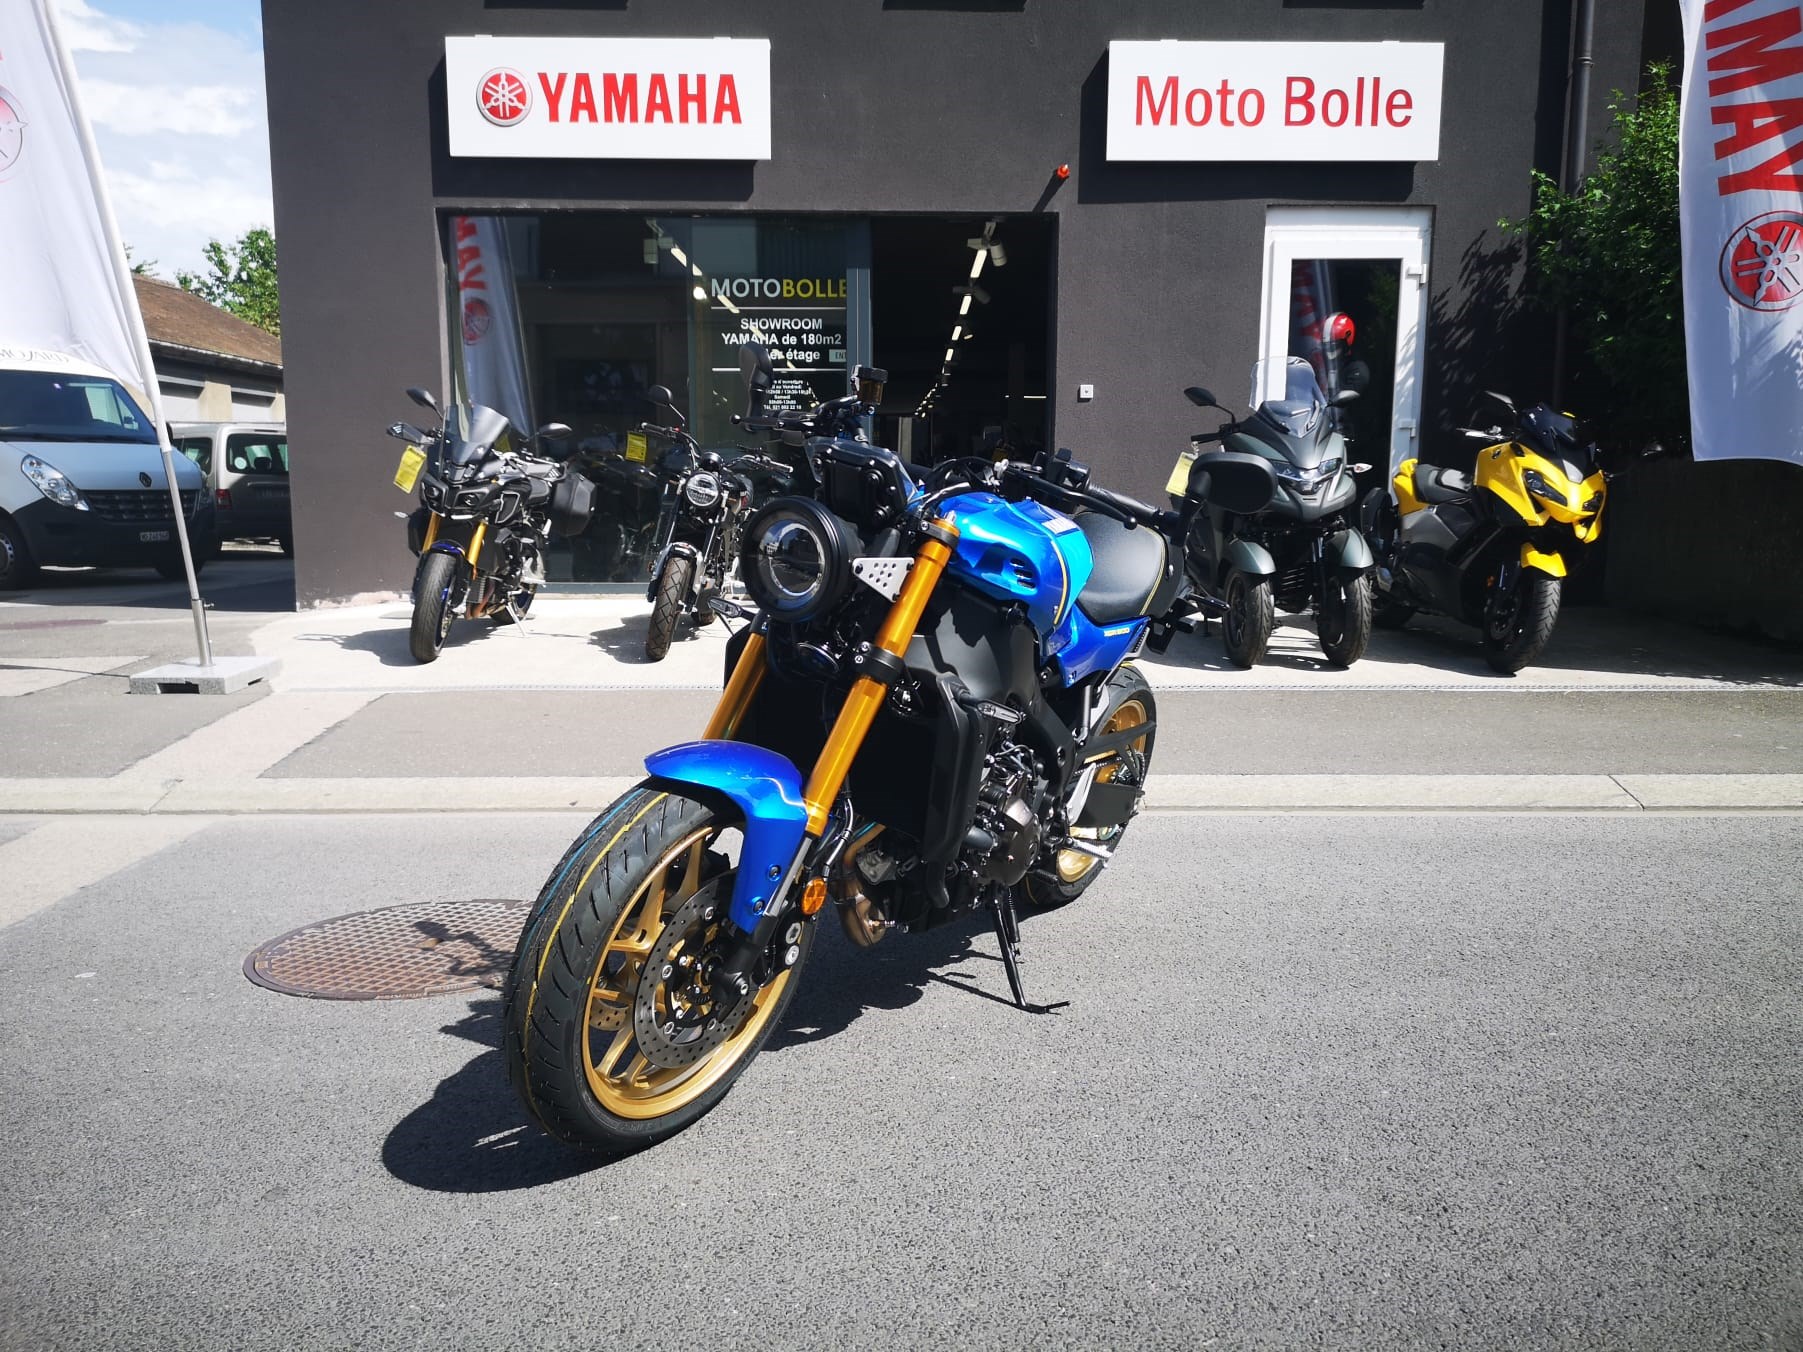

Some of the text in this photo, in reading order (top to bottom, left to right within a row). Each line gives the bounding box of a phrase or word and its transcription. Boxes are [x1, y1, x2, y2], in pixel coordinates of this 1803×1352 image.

[537, 71, 743, 125] YAMAHA
[1135, 75, 1413, 128] Moto Bolle
[740, 318, 823, 330] SHOWROOM
[721, 332, 842, 345] YAMAHA de 180m2
[785, 347, 820, 363] étage
